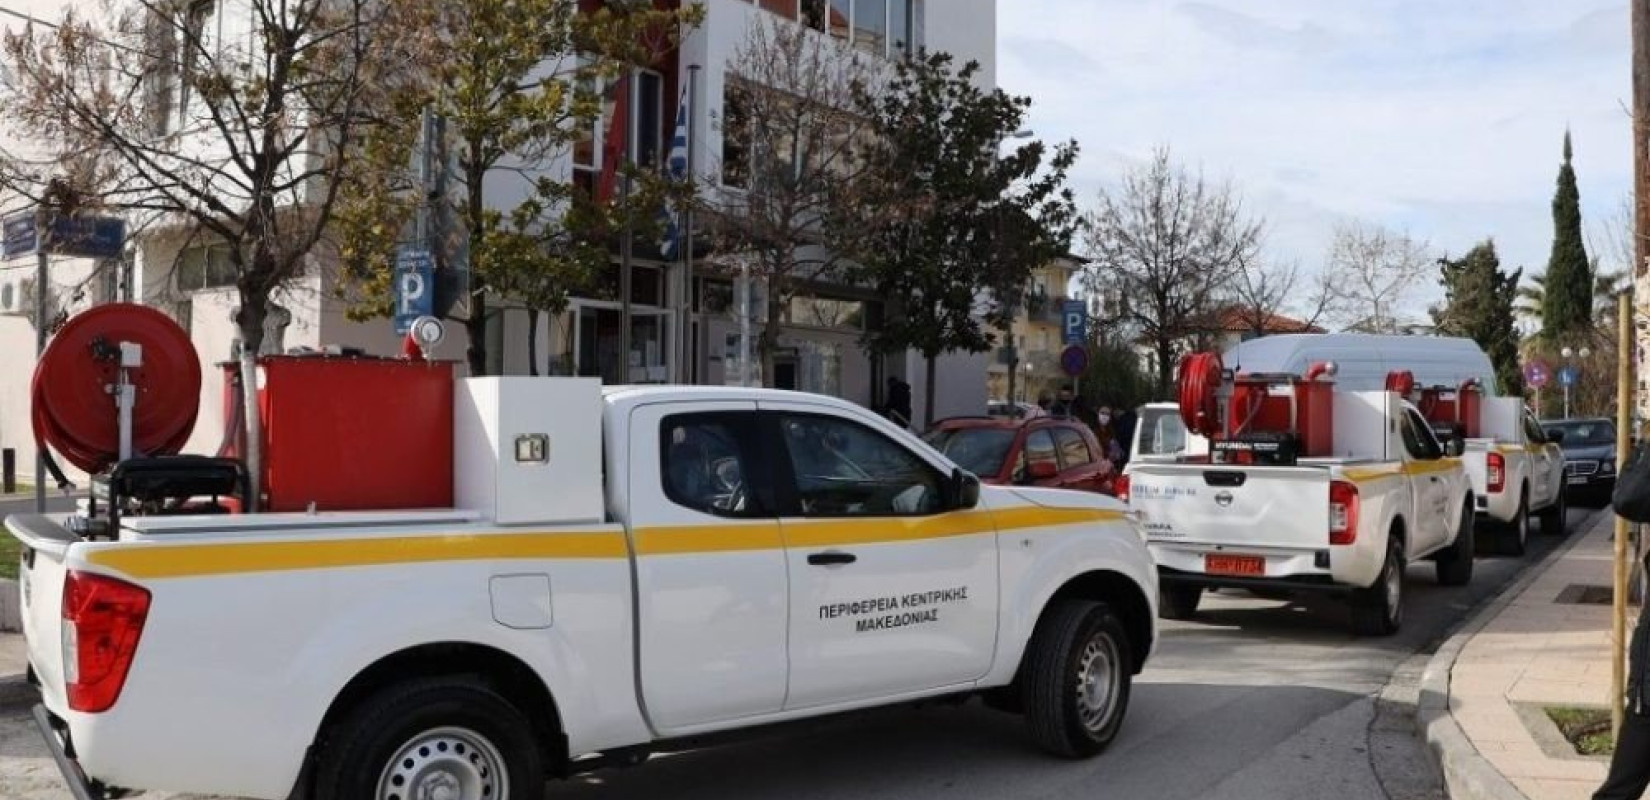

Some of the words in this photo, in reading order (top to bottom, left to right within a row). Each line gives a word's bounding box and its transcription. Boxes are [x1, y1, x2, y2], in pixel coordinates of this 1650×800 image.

[402, 273, 424, 314] P
[1067, 313, 1081, 334] P
[819, 595, 898, 619] ΠΕΡΙΦΕΡΕΙΑ
[901, 586, 968, 608] ΚΕΝΤΡΙΚΗΣ
[856, 608, 938, 632] ΜΑΚΕΔΟΝΙΑΣ
